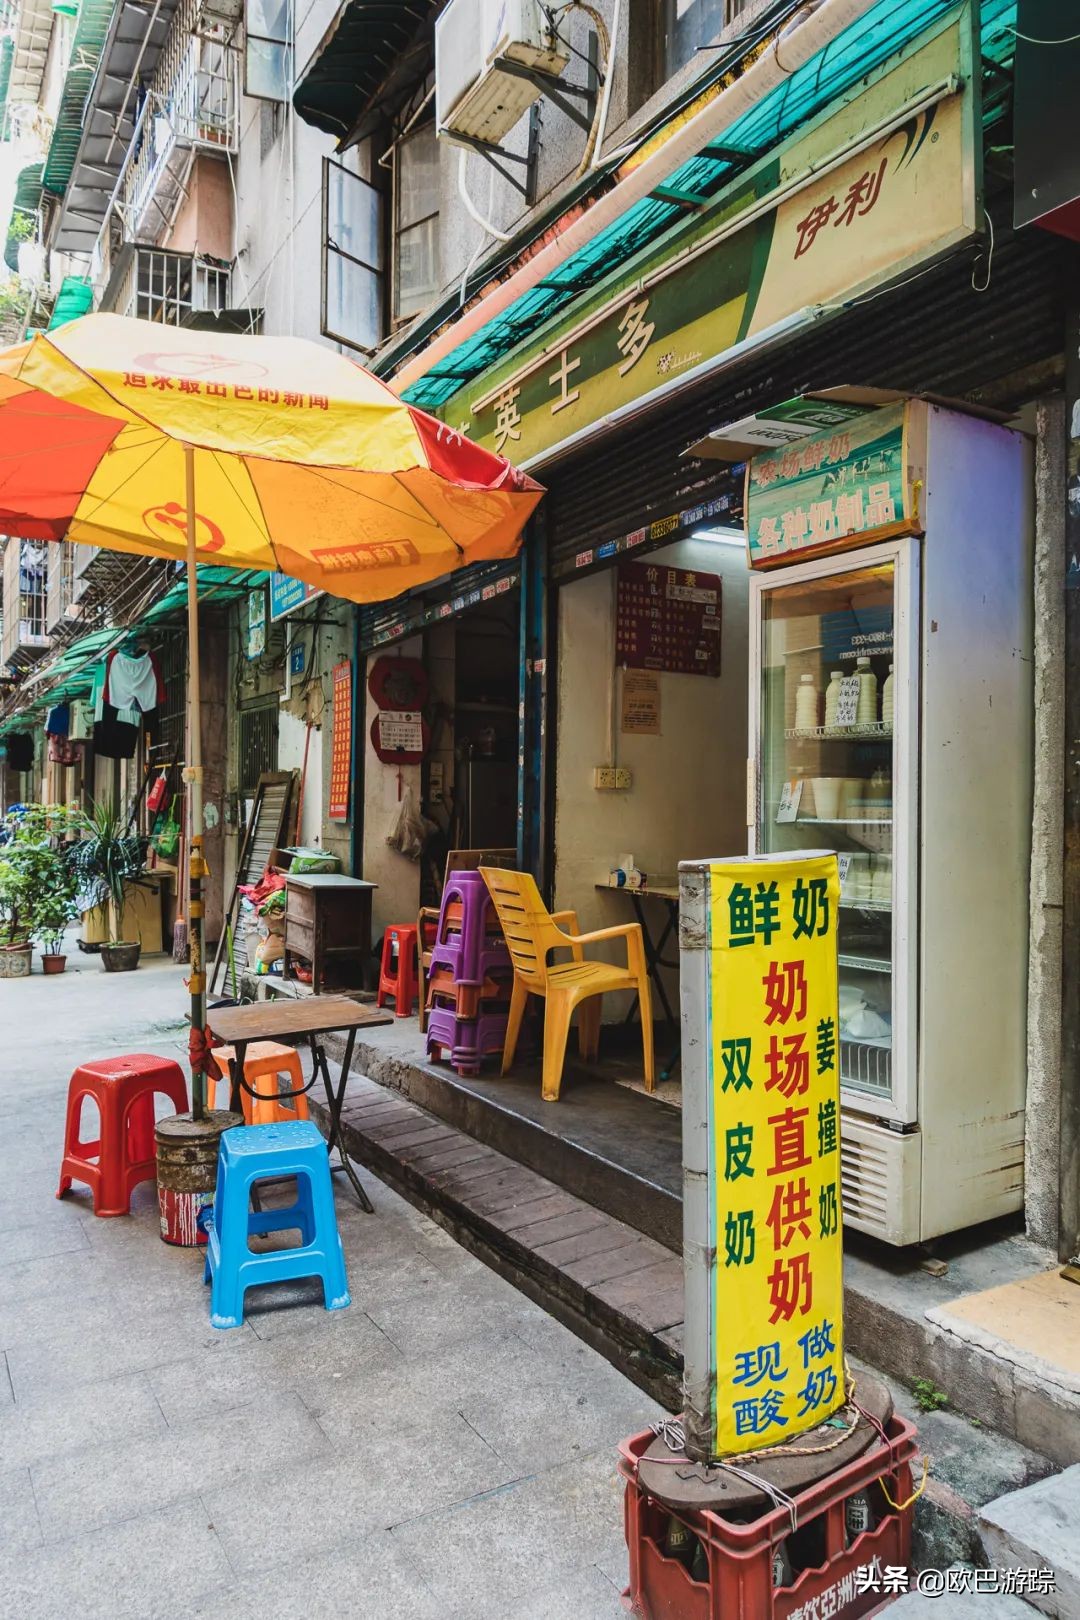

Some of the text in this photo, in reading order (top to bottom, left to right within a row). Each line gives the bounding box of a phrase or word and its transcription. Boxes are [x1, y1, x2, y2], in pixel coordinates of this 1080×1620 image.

[794, 157, 887, 260] 伊利
[757, 432, 850, 488] 农场鲜奶
[758, 481, 895, 554] 各种奶制品
[646, 567, 697, 587] 价目表
[728, 878, 829, 948] 鲜奶
[721, 1037, 755, 1268] 双皮奶
[762, 960, 813, 1325] 奶场直供奶
[817, 1017, 838, 1240] 姜撞奶
[733, 1319, 835, 1387] 现做
[733, 1365, 837, 1435] 酸奶
